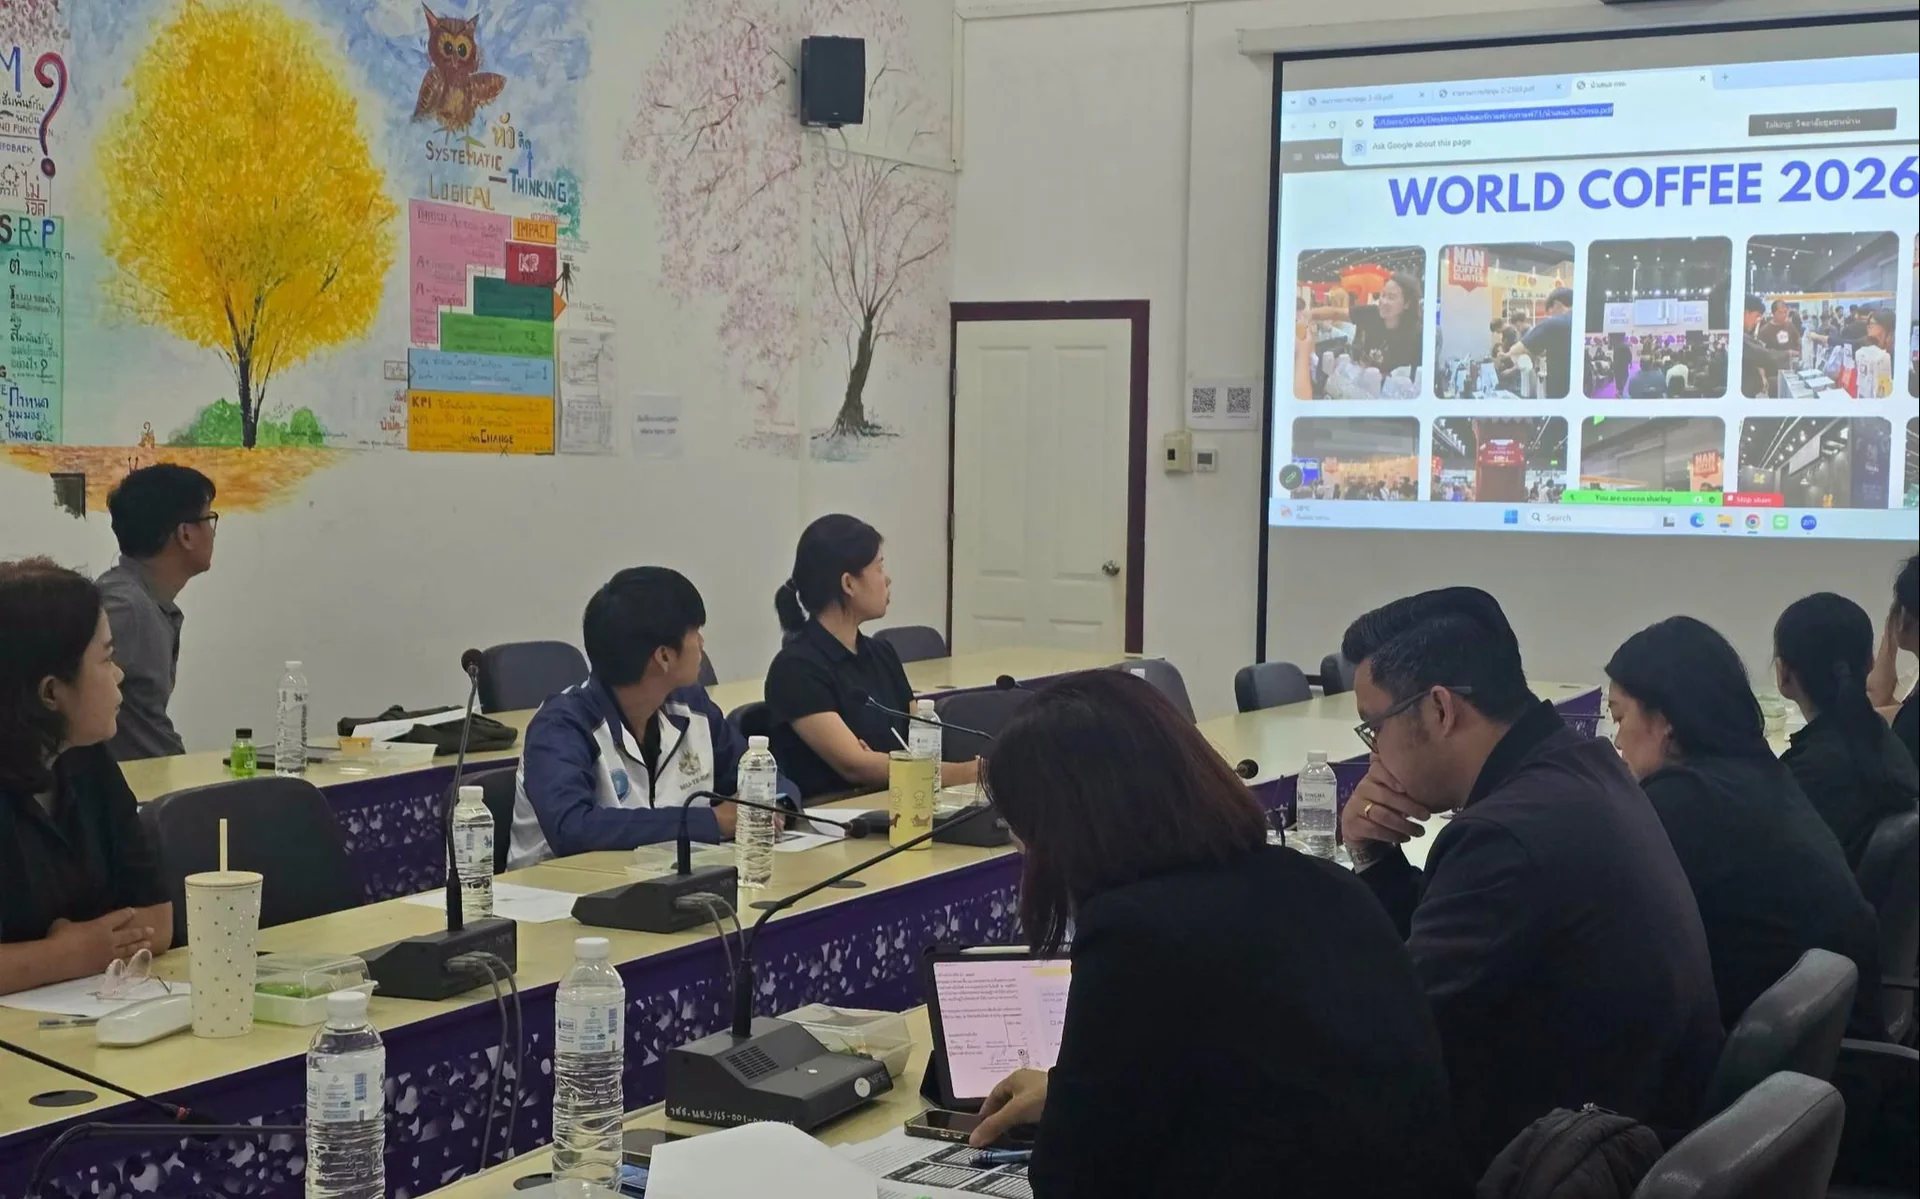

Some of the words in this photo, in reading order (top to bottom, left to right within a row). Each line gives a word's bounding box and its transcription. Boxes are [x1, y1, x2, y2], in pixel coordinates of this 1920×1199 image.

[1765, 120, 1793, 130] Talking:
[1372, 142, 1386, 151] Ask
[1387, 141, 1413, 151] Google
[1415, 140, 1436, 148] about
[1438, 139, 1451, 147] this
[1452, 139, 1471, 148] page
[425, 140, 503, 172] SYSTEMATIC
[428, 174, 496, 212] LOGICAL
[508, 168, 568, 204] THINKING
[1388, 171, 1565, 217] WORLD
[1577, 162, 1763, 210] COFFEE
[1778, 155, 1919, 203] 2026
[516, 221, 550, 240] IMPACT
[1453, 246, 1485, 267] NAN
[412, 396, 431, 408] KPI
[1595, 494, 1610, 502] You
[1647, 495, 1672, 504] sharing
[1736, 496, 1752, 505] Stop
[1753, 496, 1772, 504] share
[1546, 512, 1572, 523] Search
